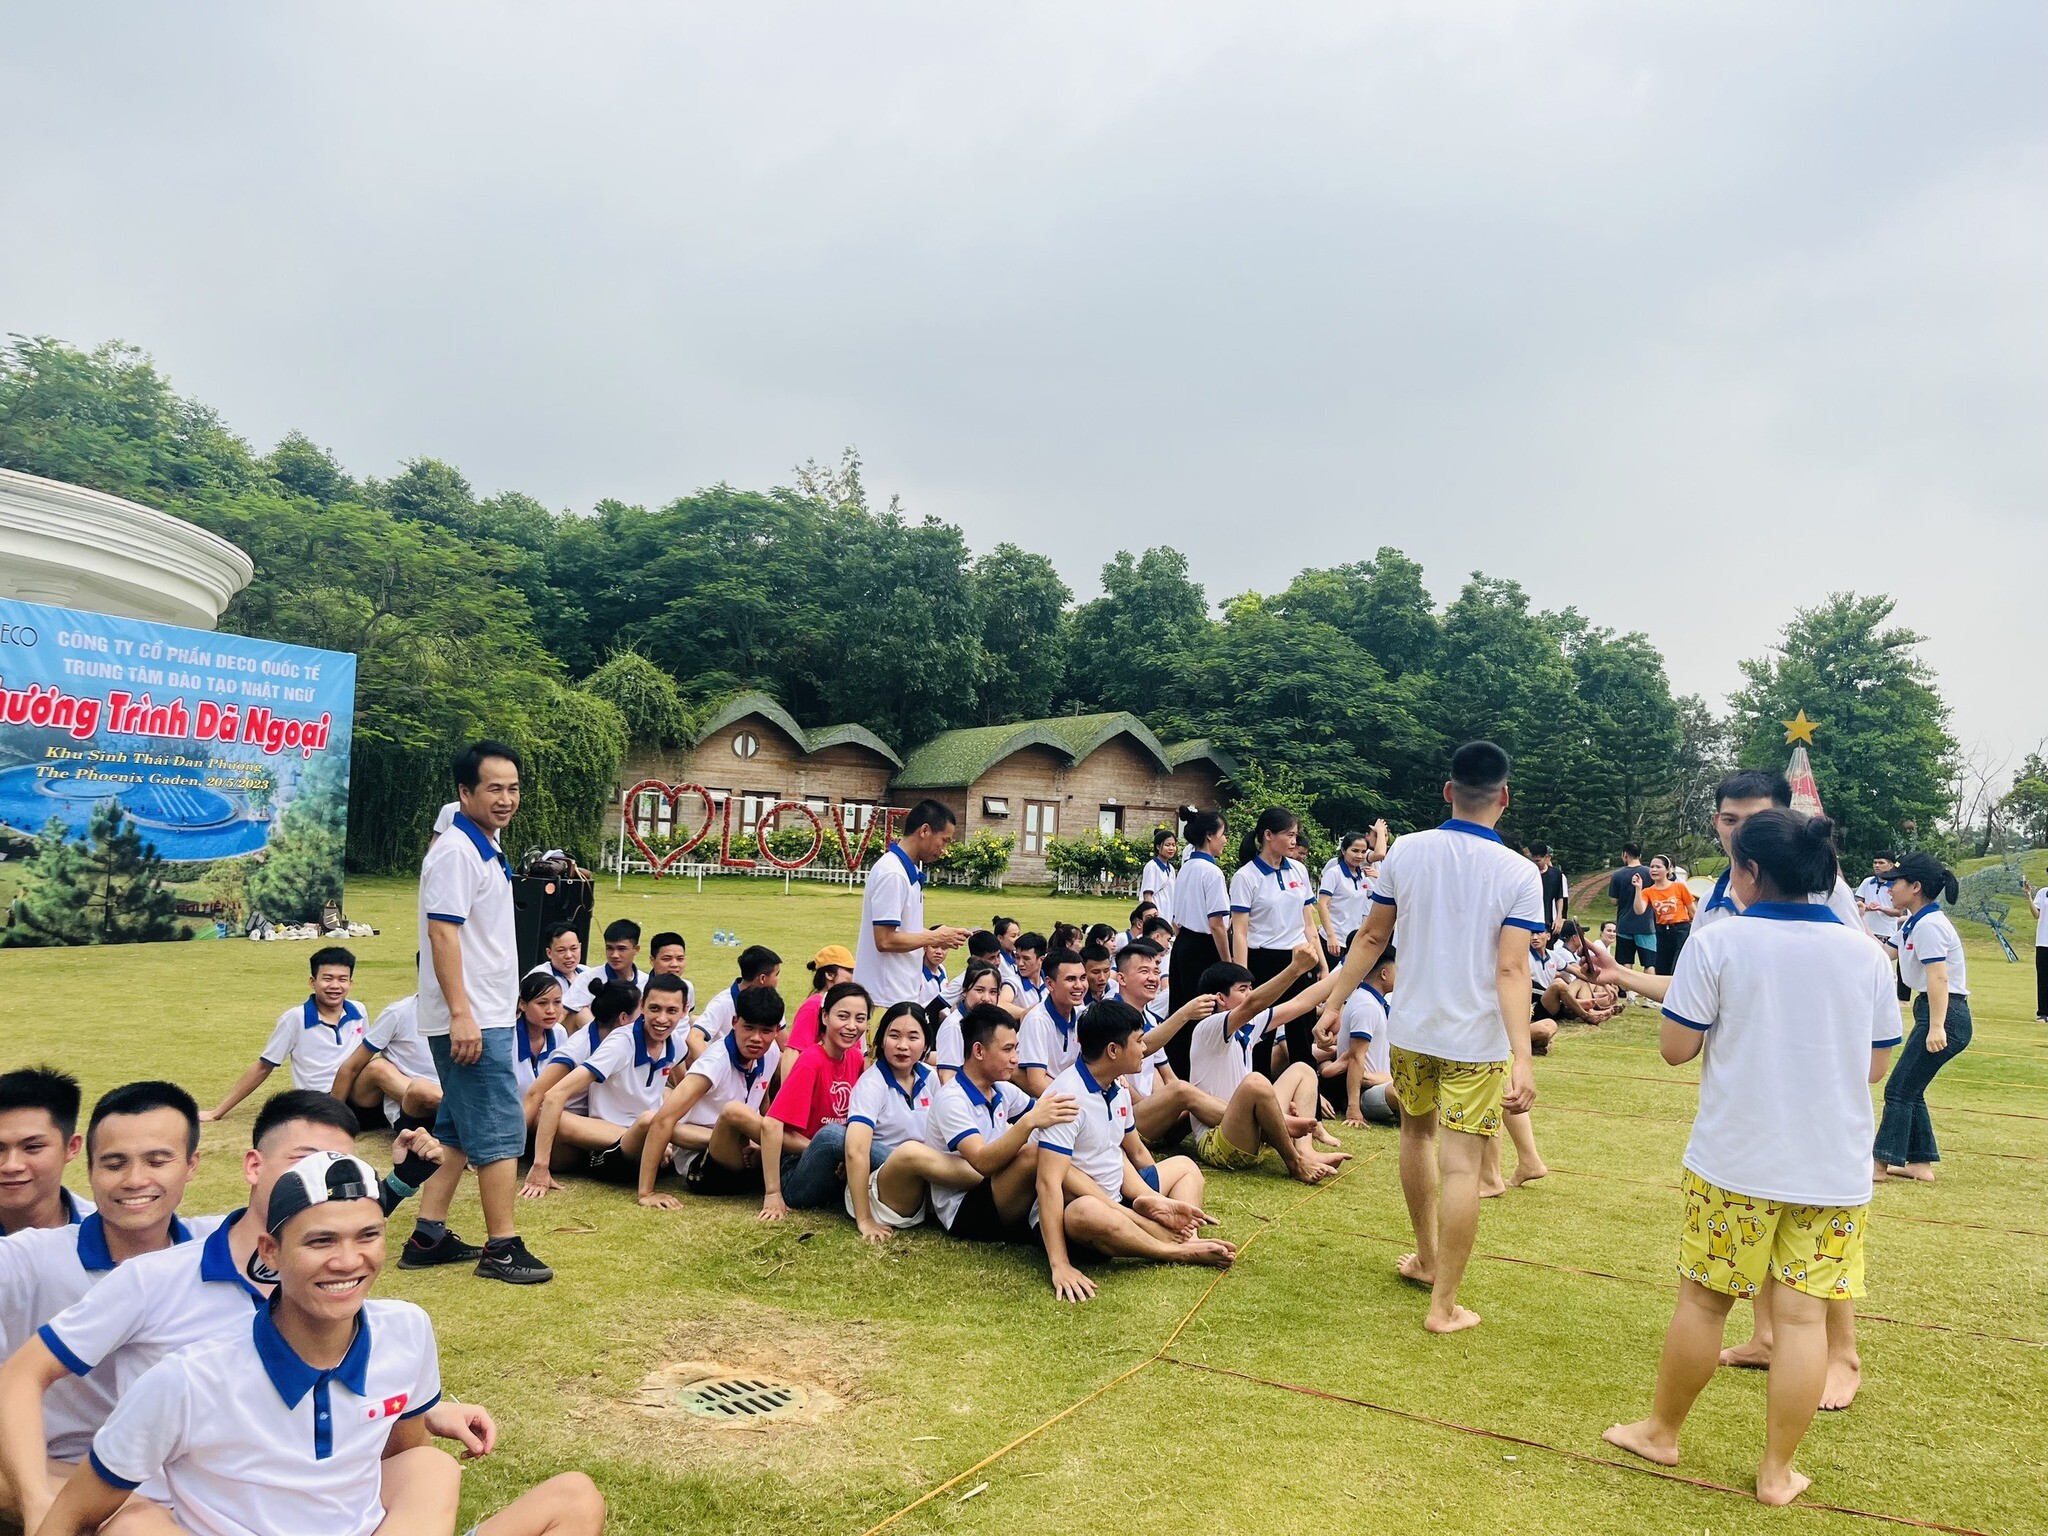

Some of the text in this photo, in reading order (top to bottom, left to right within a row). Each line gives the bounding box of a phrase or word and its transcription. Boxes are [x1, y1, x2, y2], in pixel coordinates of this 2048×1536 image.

[58, 630, 321, 681] CÔNG TY CỔ PHẦN DECO QUỐC TẾ
[63, 658, 316, 703] TRUNG TÂM ĐÀO TẠO NHẬT NGỮ
[107, 690, 190, 738] Trình
[194, 700, 240, 743] Dã
[242, 705, 332, 760] Ngoại
[36, 766, 270, 790] The Phoenix Gaden, 20/5/2023
[45, 746, 264, 774] Khu Sinh Thái Đan Phượng
